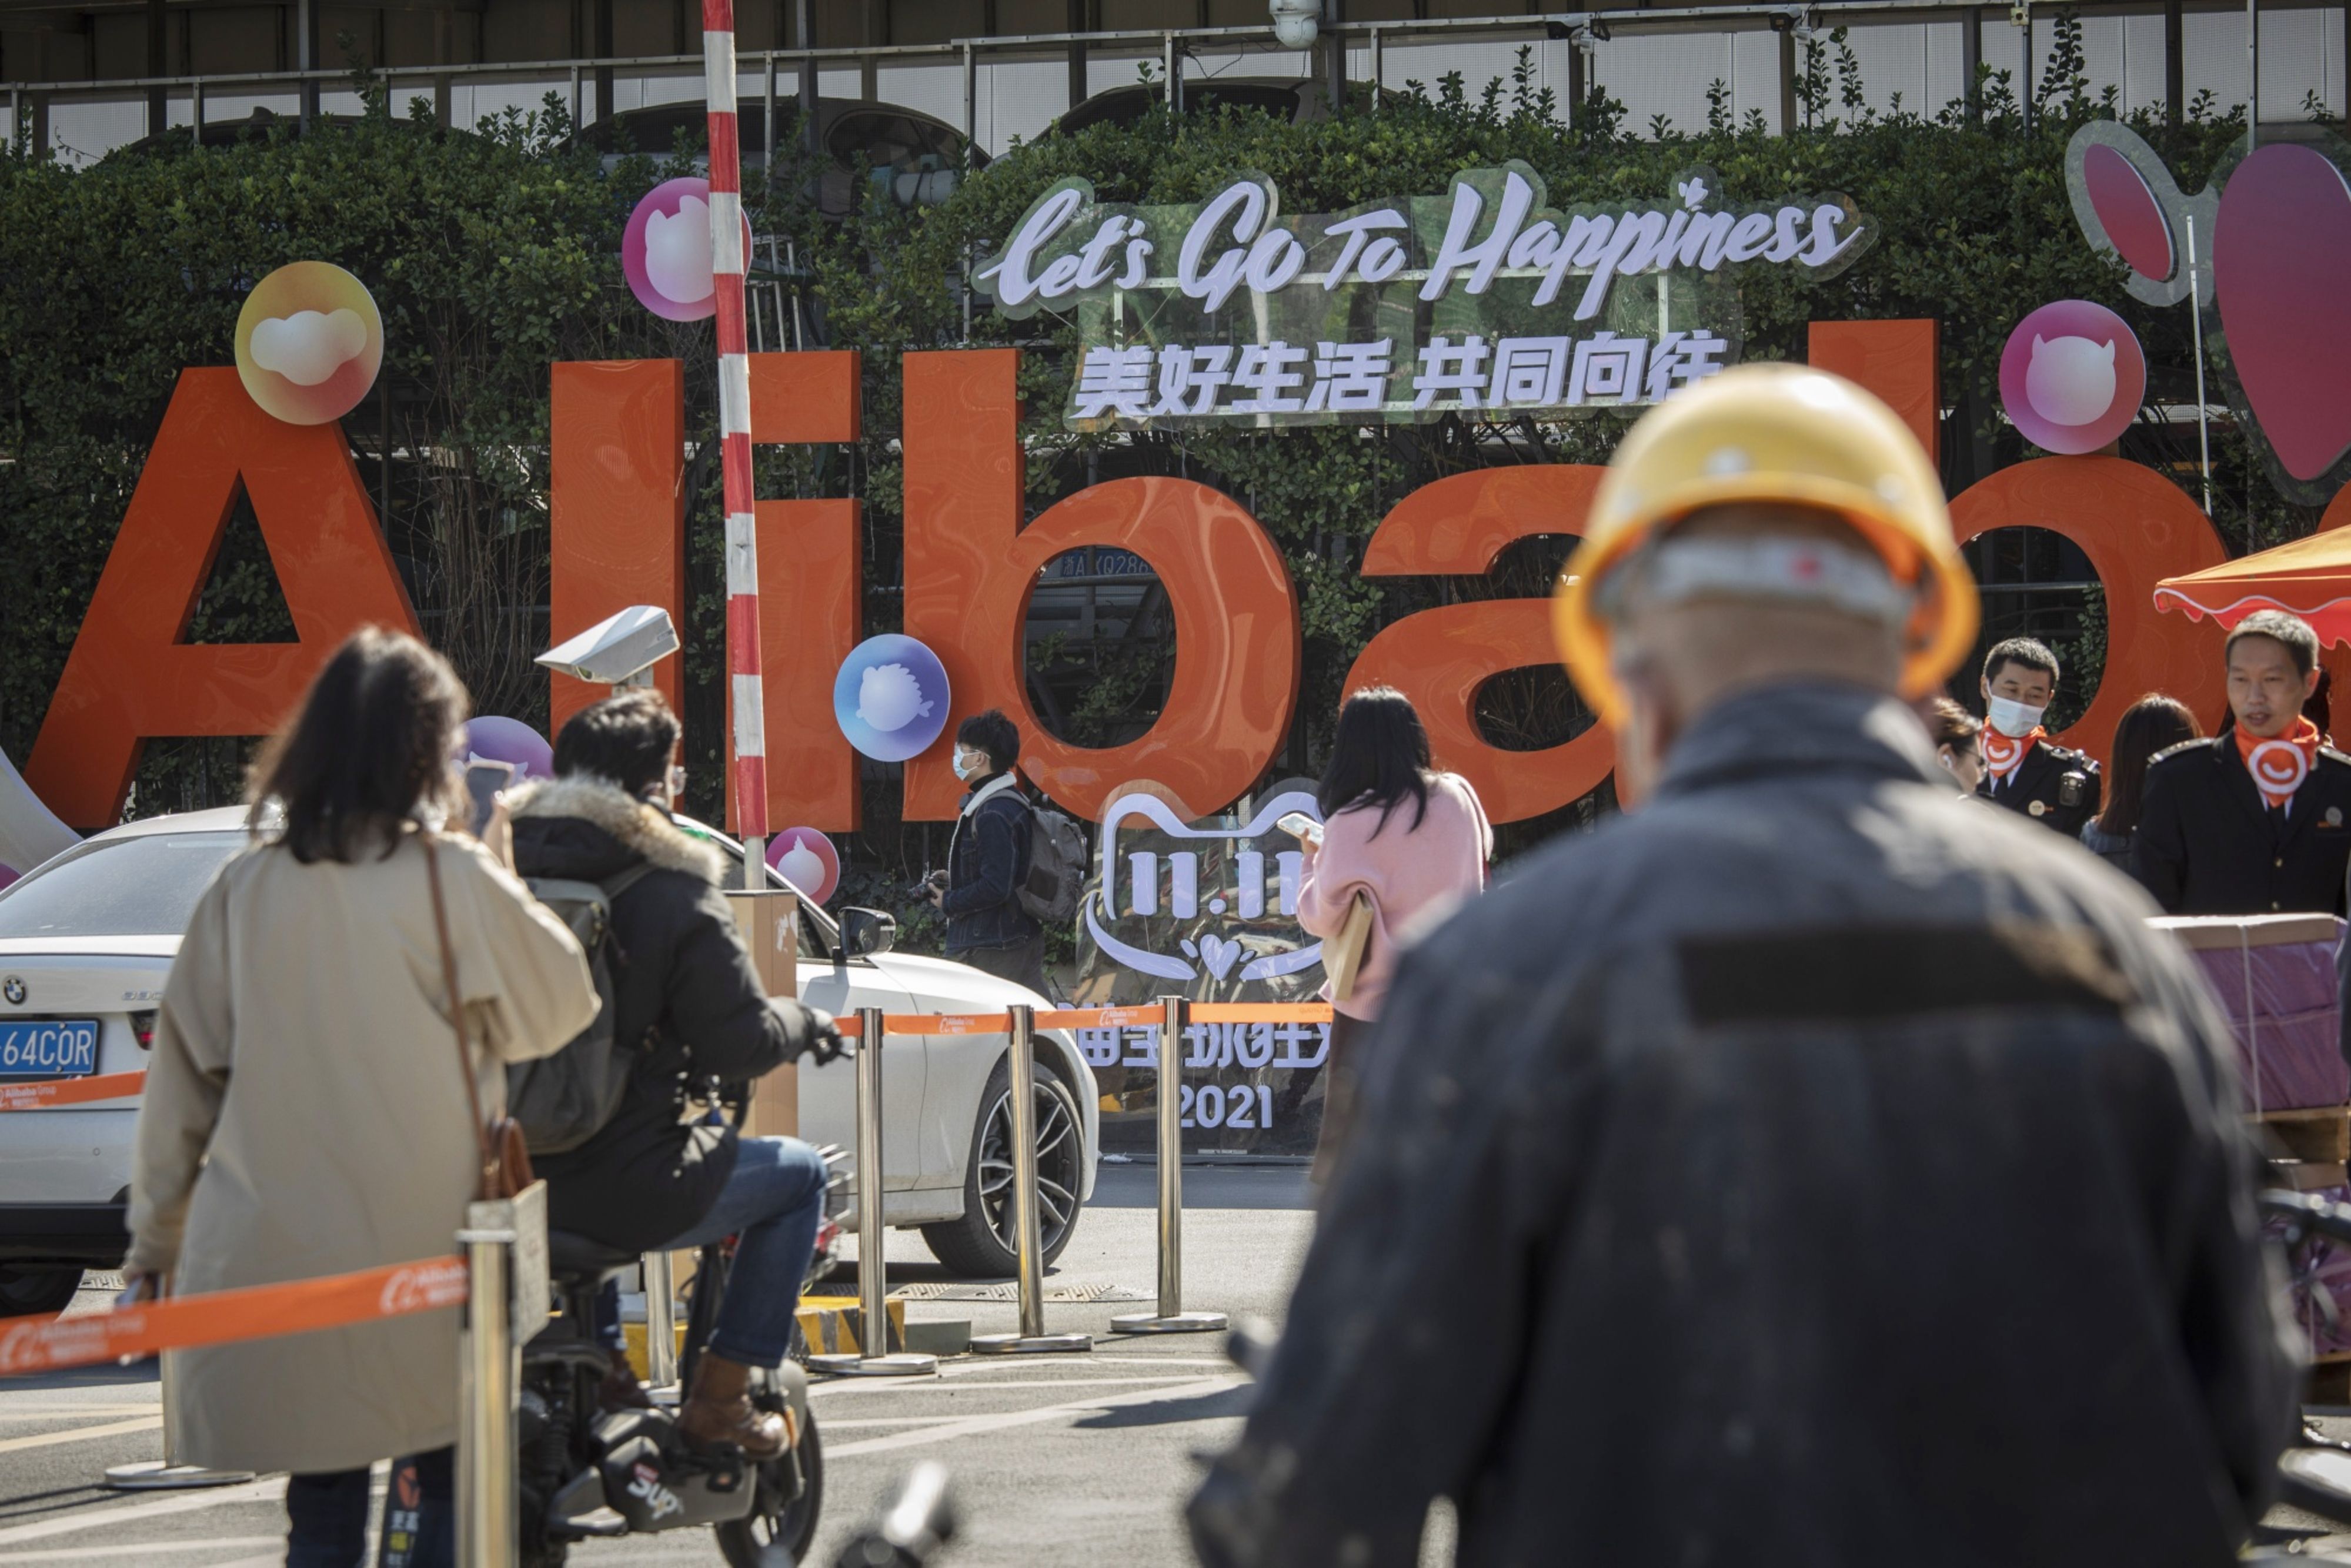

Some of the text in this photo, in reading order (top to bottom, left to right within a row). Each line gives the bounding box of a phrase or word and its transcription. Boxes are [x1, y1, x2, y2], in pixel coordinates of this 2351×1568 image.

[978, 171, 1865, 322] Let's Go To Happiness
[1069, 336, 1395, 419] 美好生活
